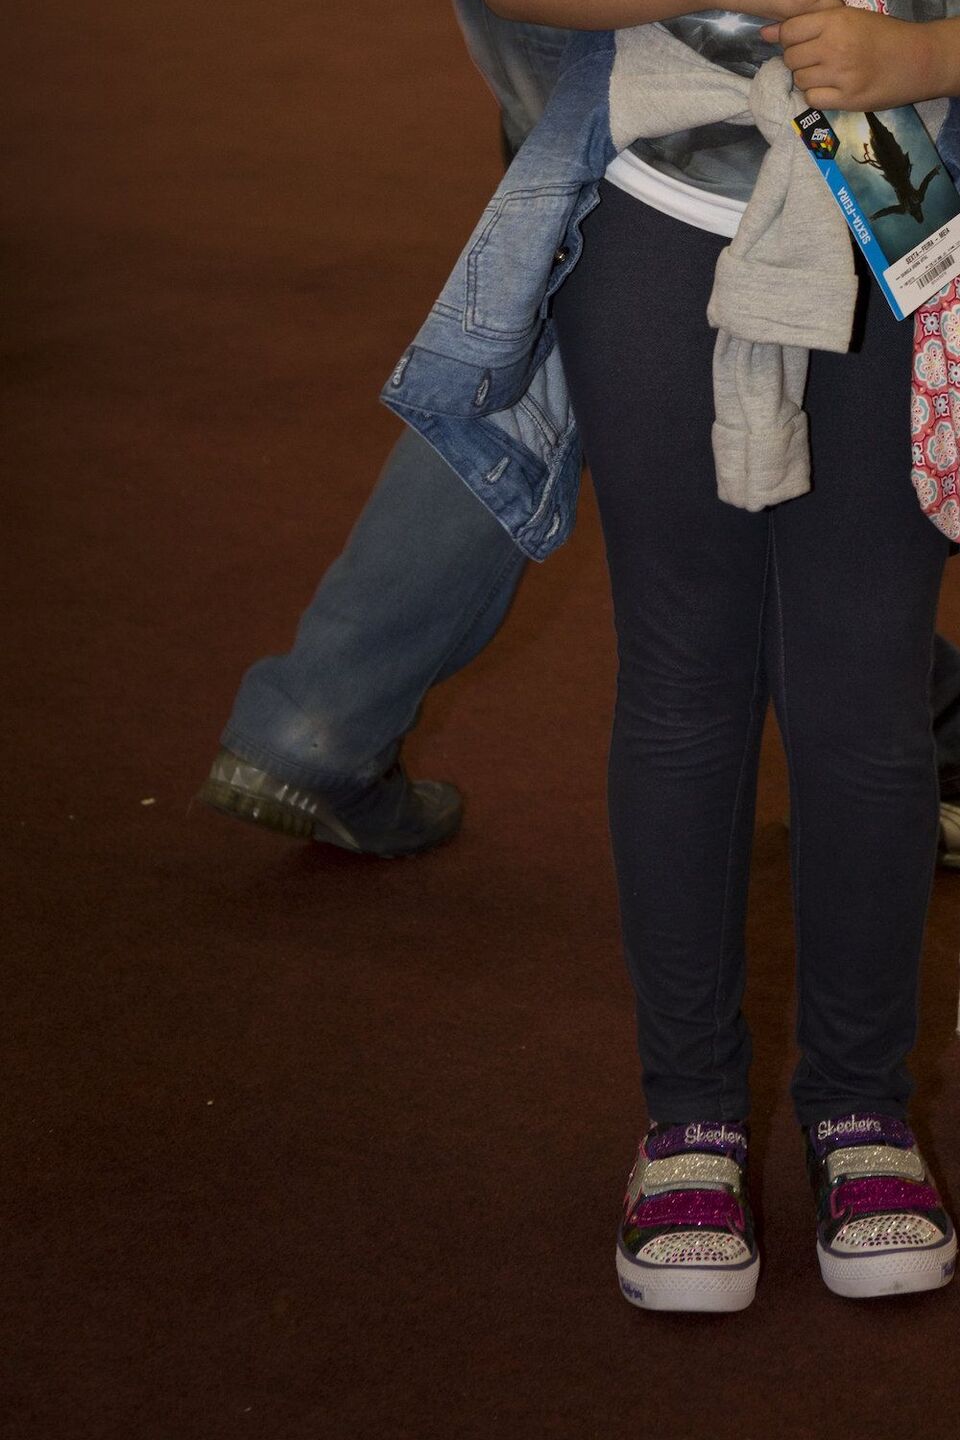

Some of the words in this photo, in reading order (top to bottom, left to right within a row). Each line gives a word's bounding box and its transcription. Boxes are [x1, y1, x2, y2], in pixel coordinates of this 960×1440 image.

[799, 111, 822, 129] 2016
[837, 186, 871, 245] SEXTA-FEIRA
[905, 240, 935, 264] SEXTA-FEIRA
[817, 1114, 882, 1140] Skechers
